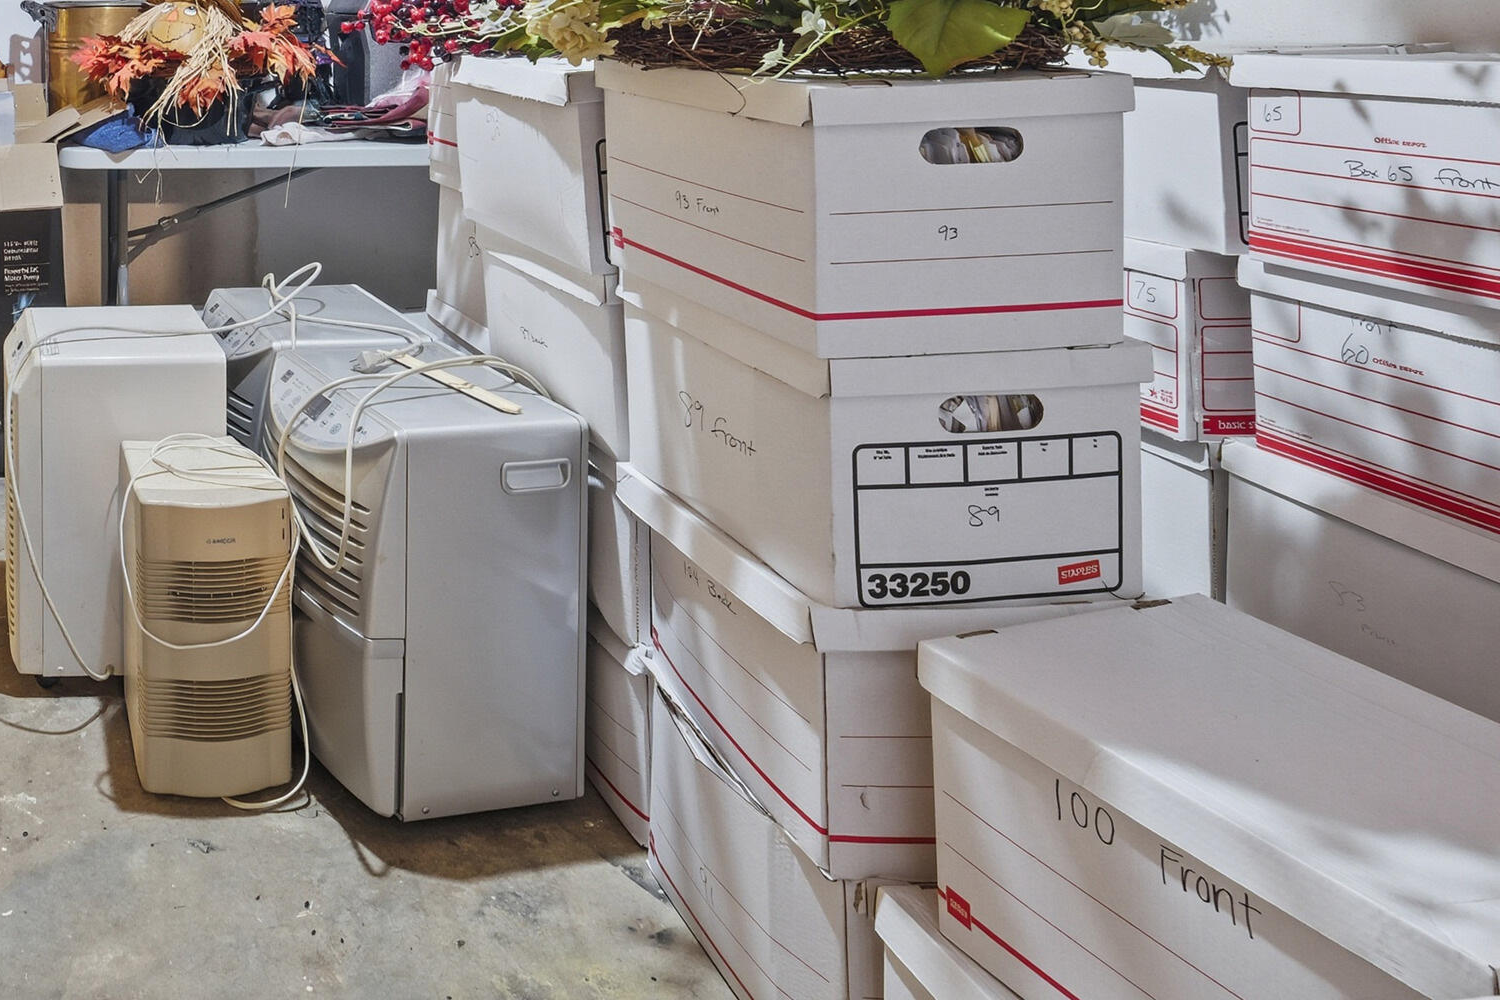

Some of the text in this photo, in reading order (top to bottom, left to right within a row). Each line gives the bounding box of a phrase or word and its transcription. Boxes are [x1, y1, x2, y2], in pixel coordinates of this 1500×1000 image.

[1264, 103, 1283, 123] 65
[1344, 160, 1379, 179] Box
[1387, 165, 1414, 182] 65
[938, 224, 958, 241] 93
[1341, 333, 1369, 364] 60
[1218, 419, 1246, 430] basic
[867, 564, 1099, 600] 33250 STAPLES
[1054, 778, 1263, 940] 100 Front
